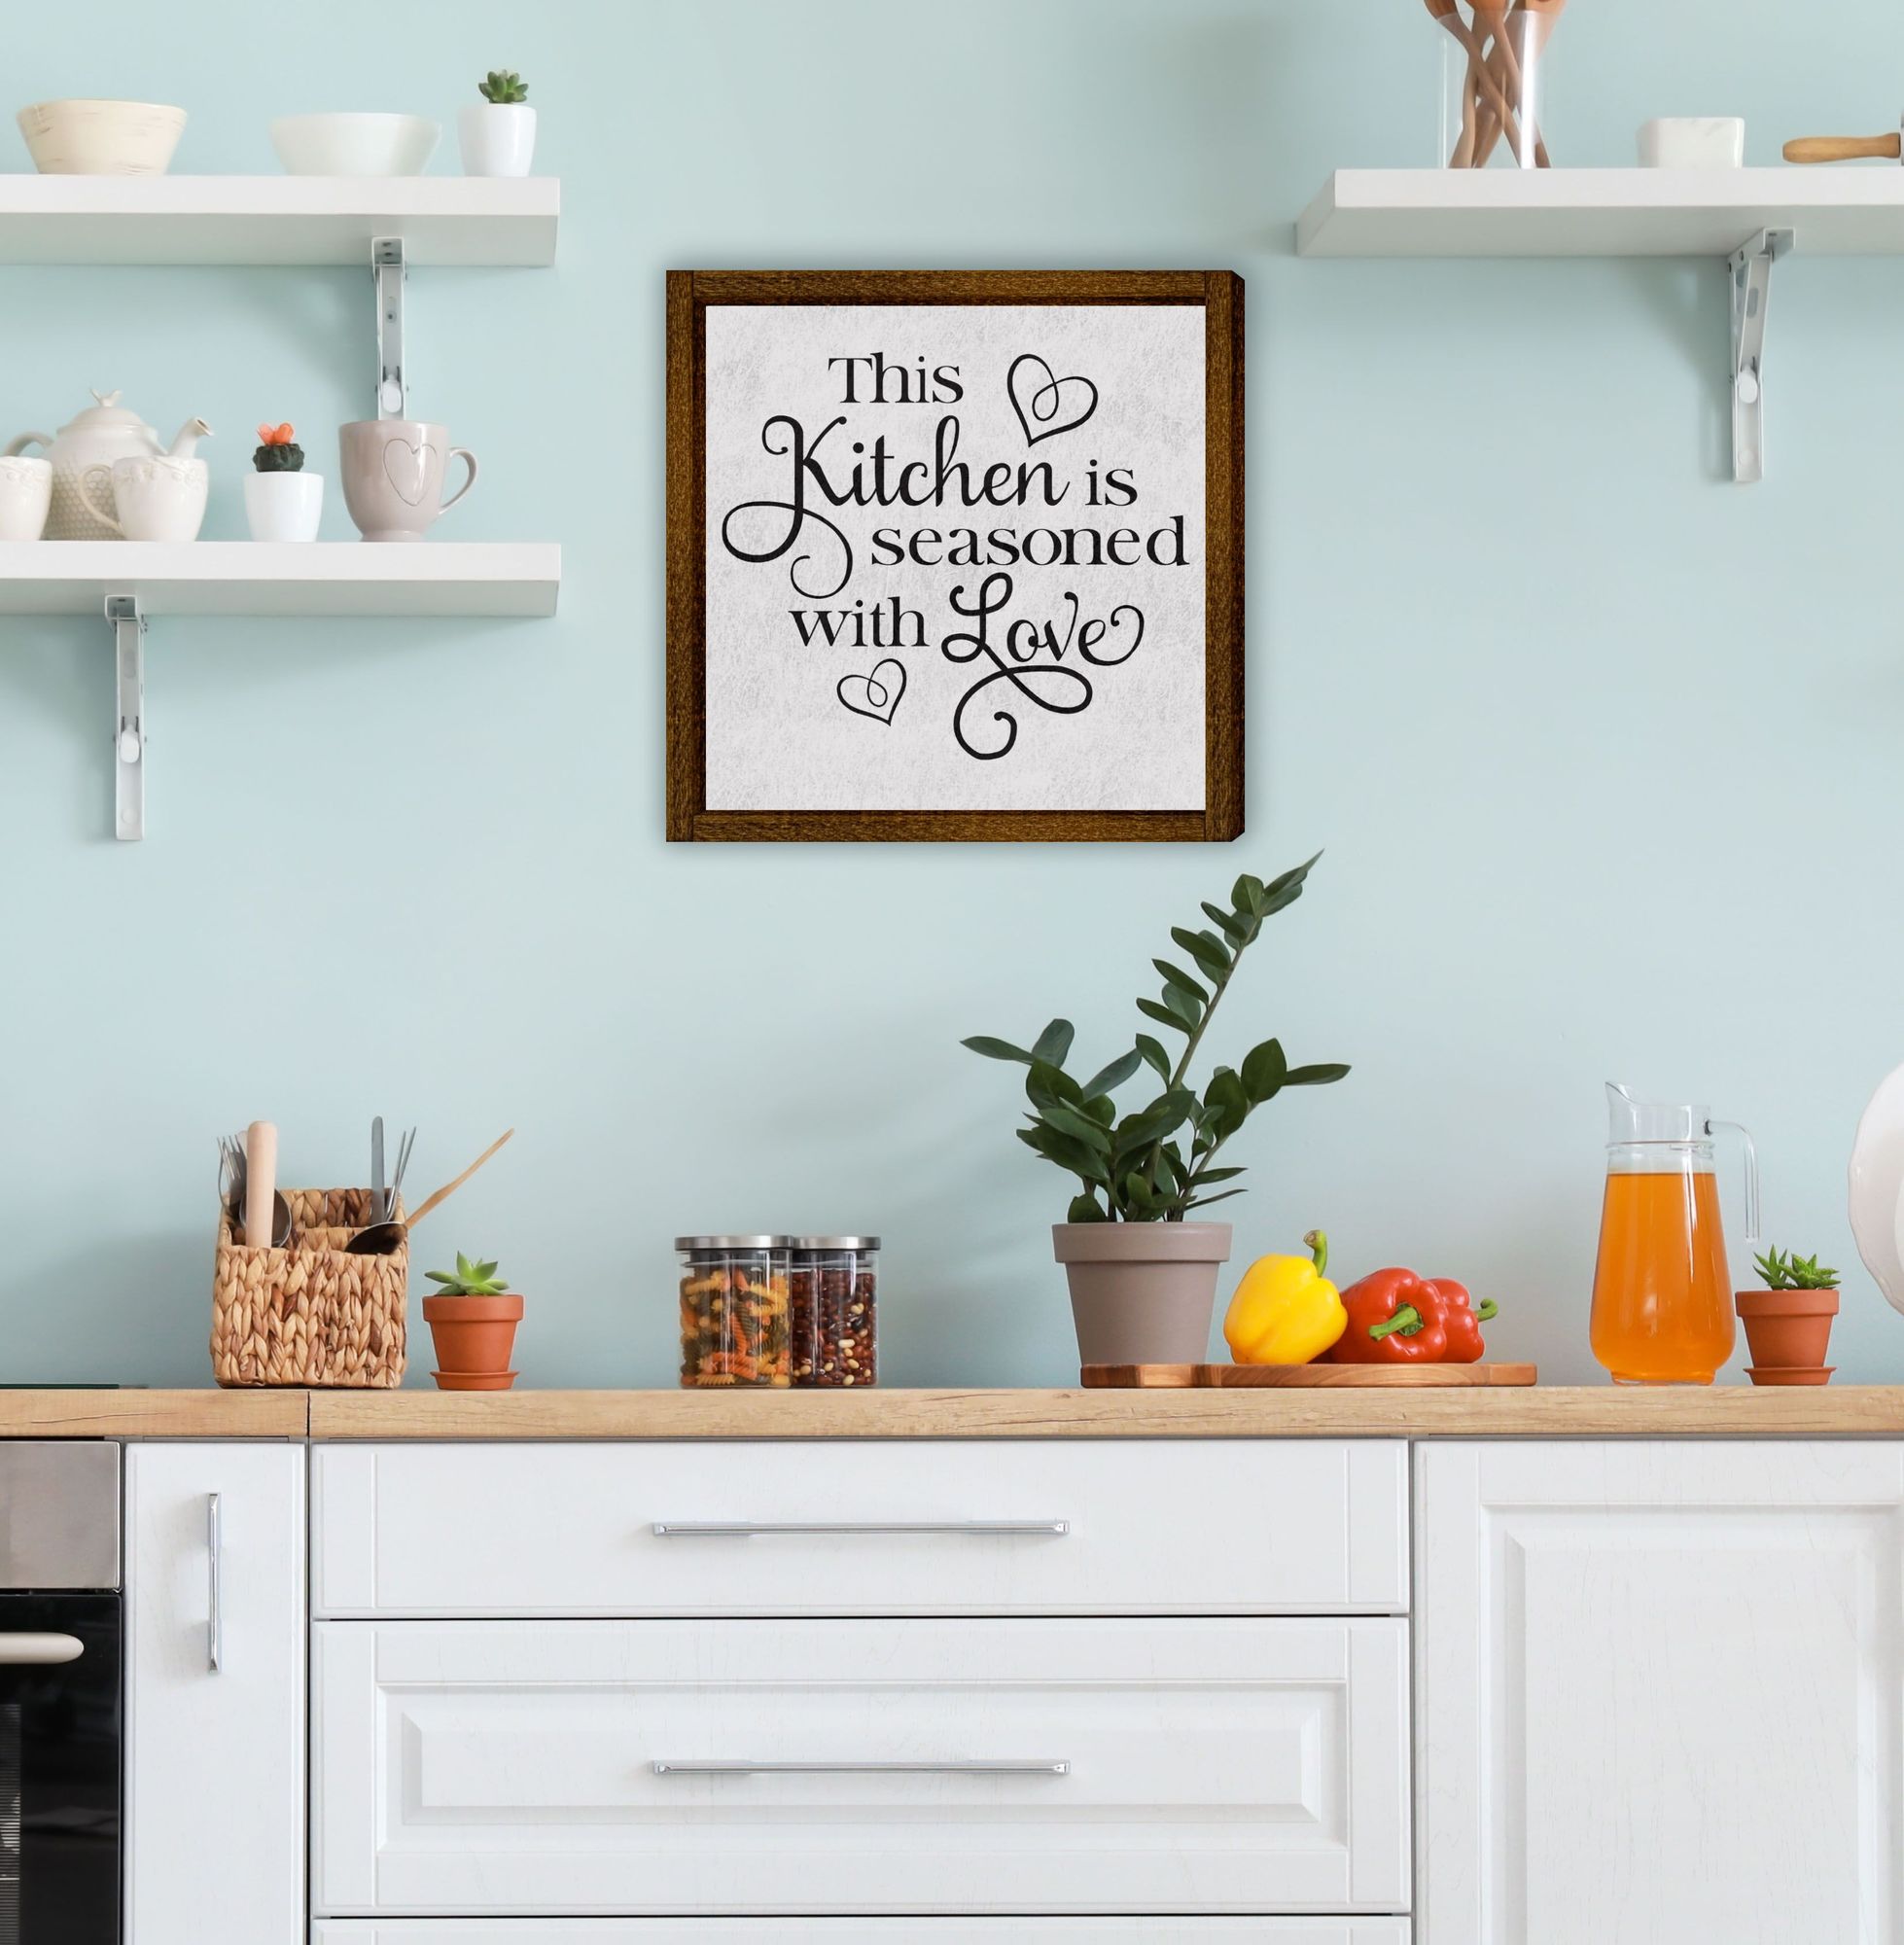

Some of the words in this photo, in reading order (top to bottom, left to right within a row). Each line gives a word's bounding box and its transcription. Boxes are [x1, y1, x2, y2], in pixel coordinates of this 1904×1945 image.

[829, 352, 963, 404] This
[723, 415, 1070, 599] Kitchen
[1085, 460, 1138, 507] is
[872, 515, 1189, 566] seasoned
[789, 597, 929, 647] with
[941, 573, 1144, 760] Love
